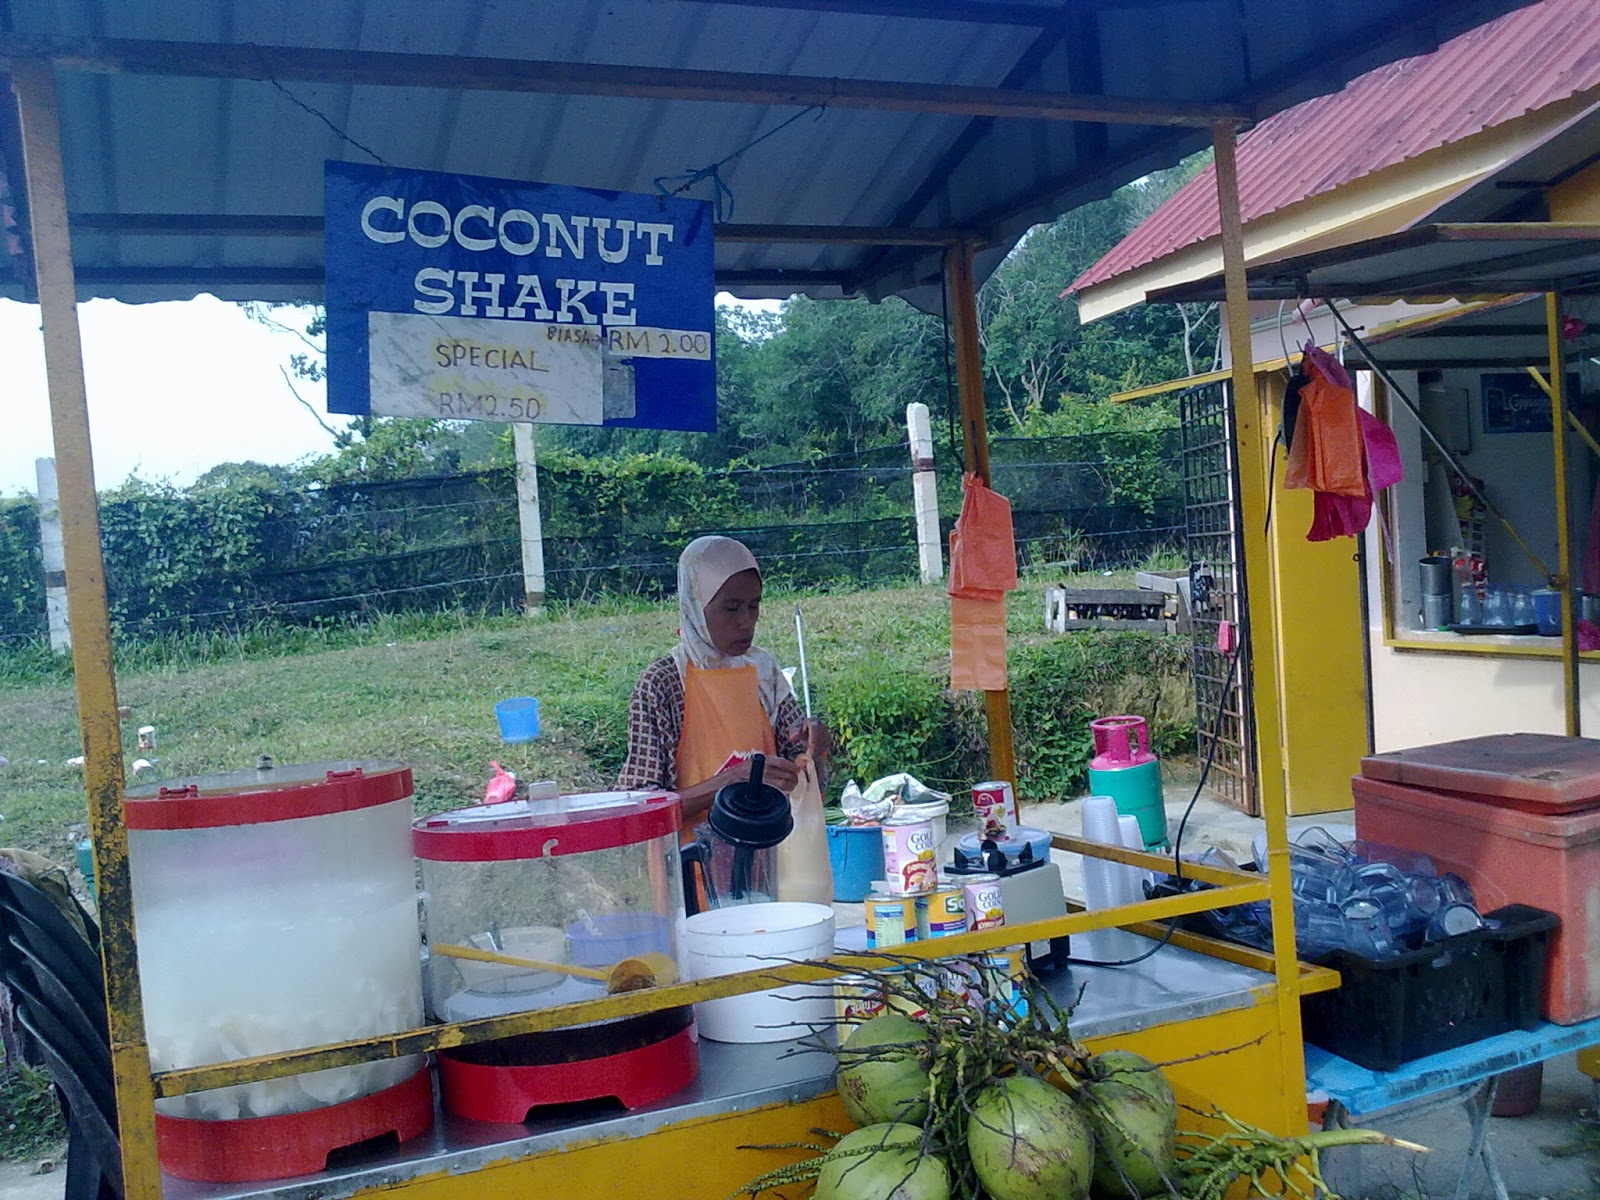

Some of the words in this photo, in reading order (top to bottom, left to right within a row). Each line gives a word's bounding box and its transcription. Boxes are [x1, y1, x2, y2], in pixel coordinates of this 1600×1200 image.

[361, 196, 674, 266] COCONUT
[414, 267, 637, 326] SHAKE
[436, 343, 549, 373] SPECIAL
[439, 392, 541, 421] RM2.50
